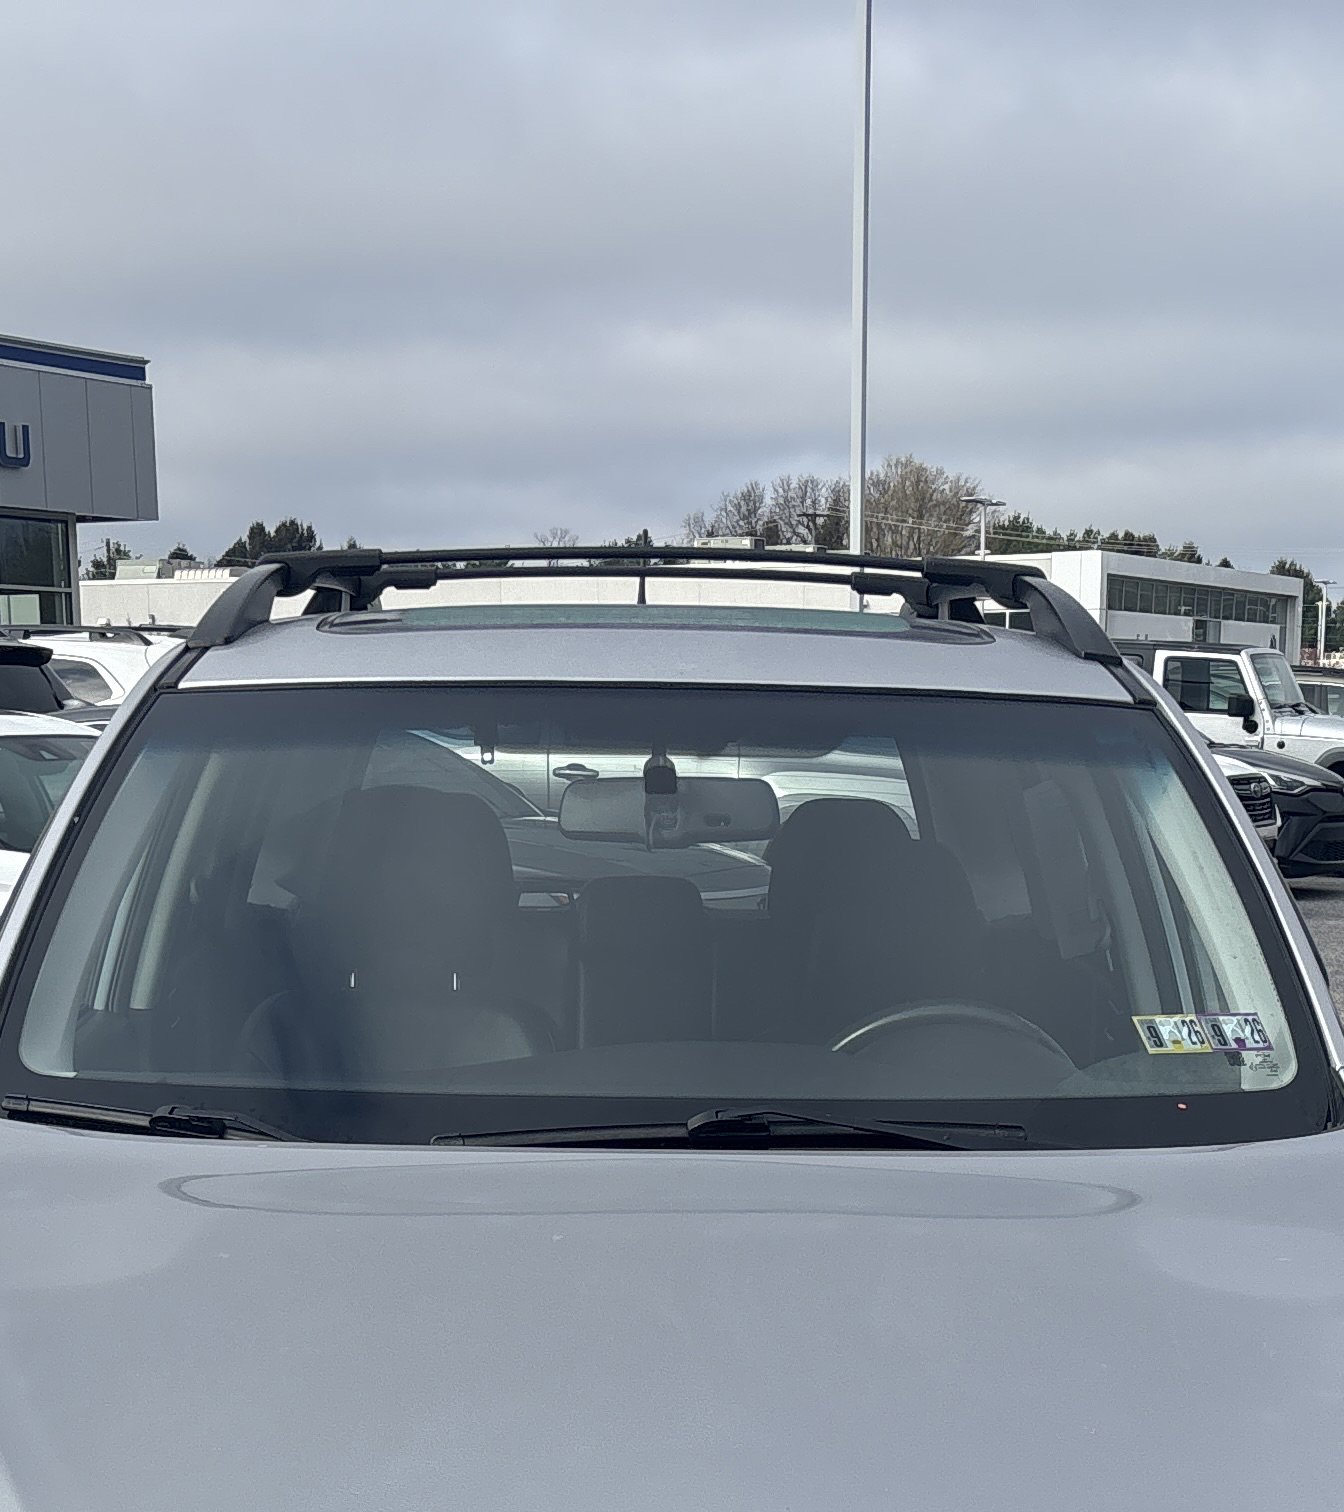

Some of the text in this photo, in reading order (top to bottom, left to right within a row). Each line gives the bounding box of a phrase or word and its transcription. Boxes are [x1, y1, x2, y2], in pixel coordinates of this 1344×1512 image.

[1146, 1019, 1205, 1048] 9 26
[1210, 1017, 1268, 1047] 9 26
